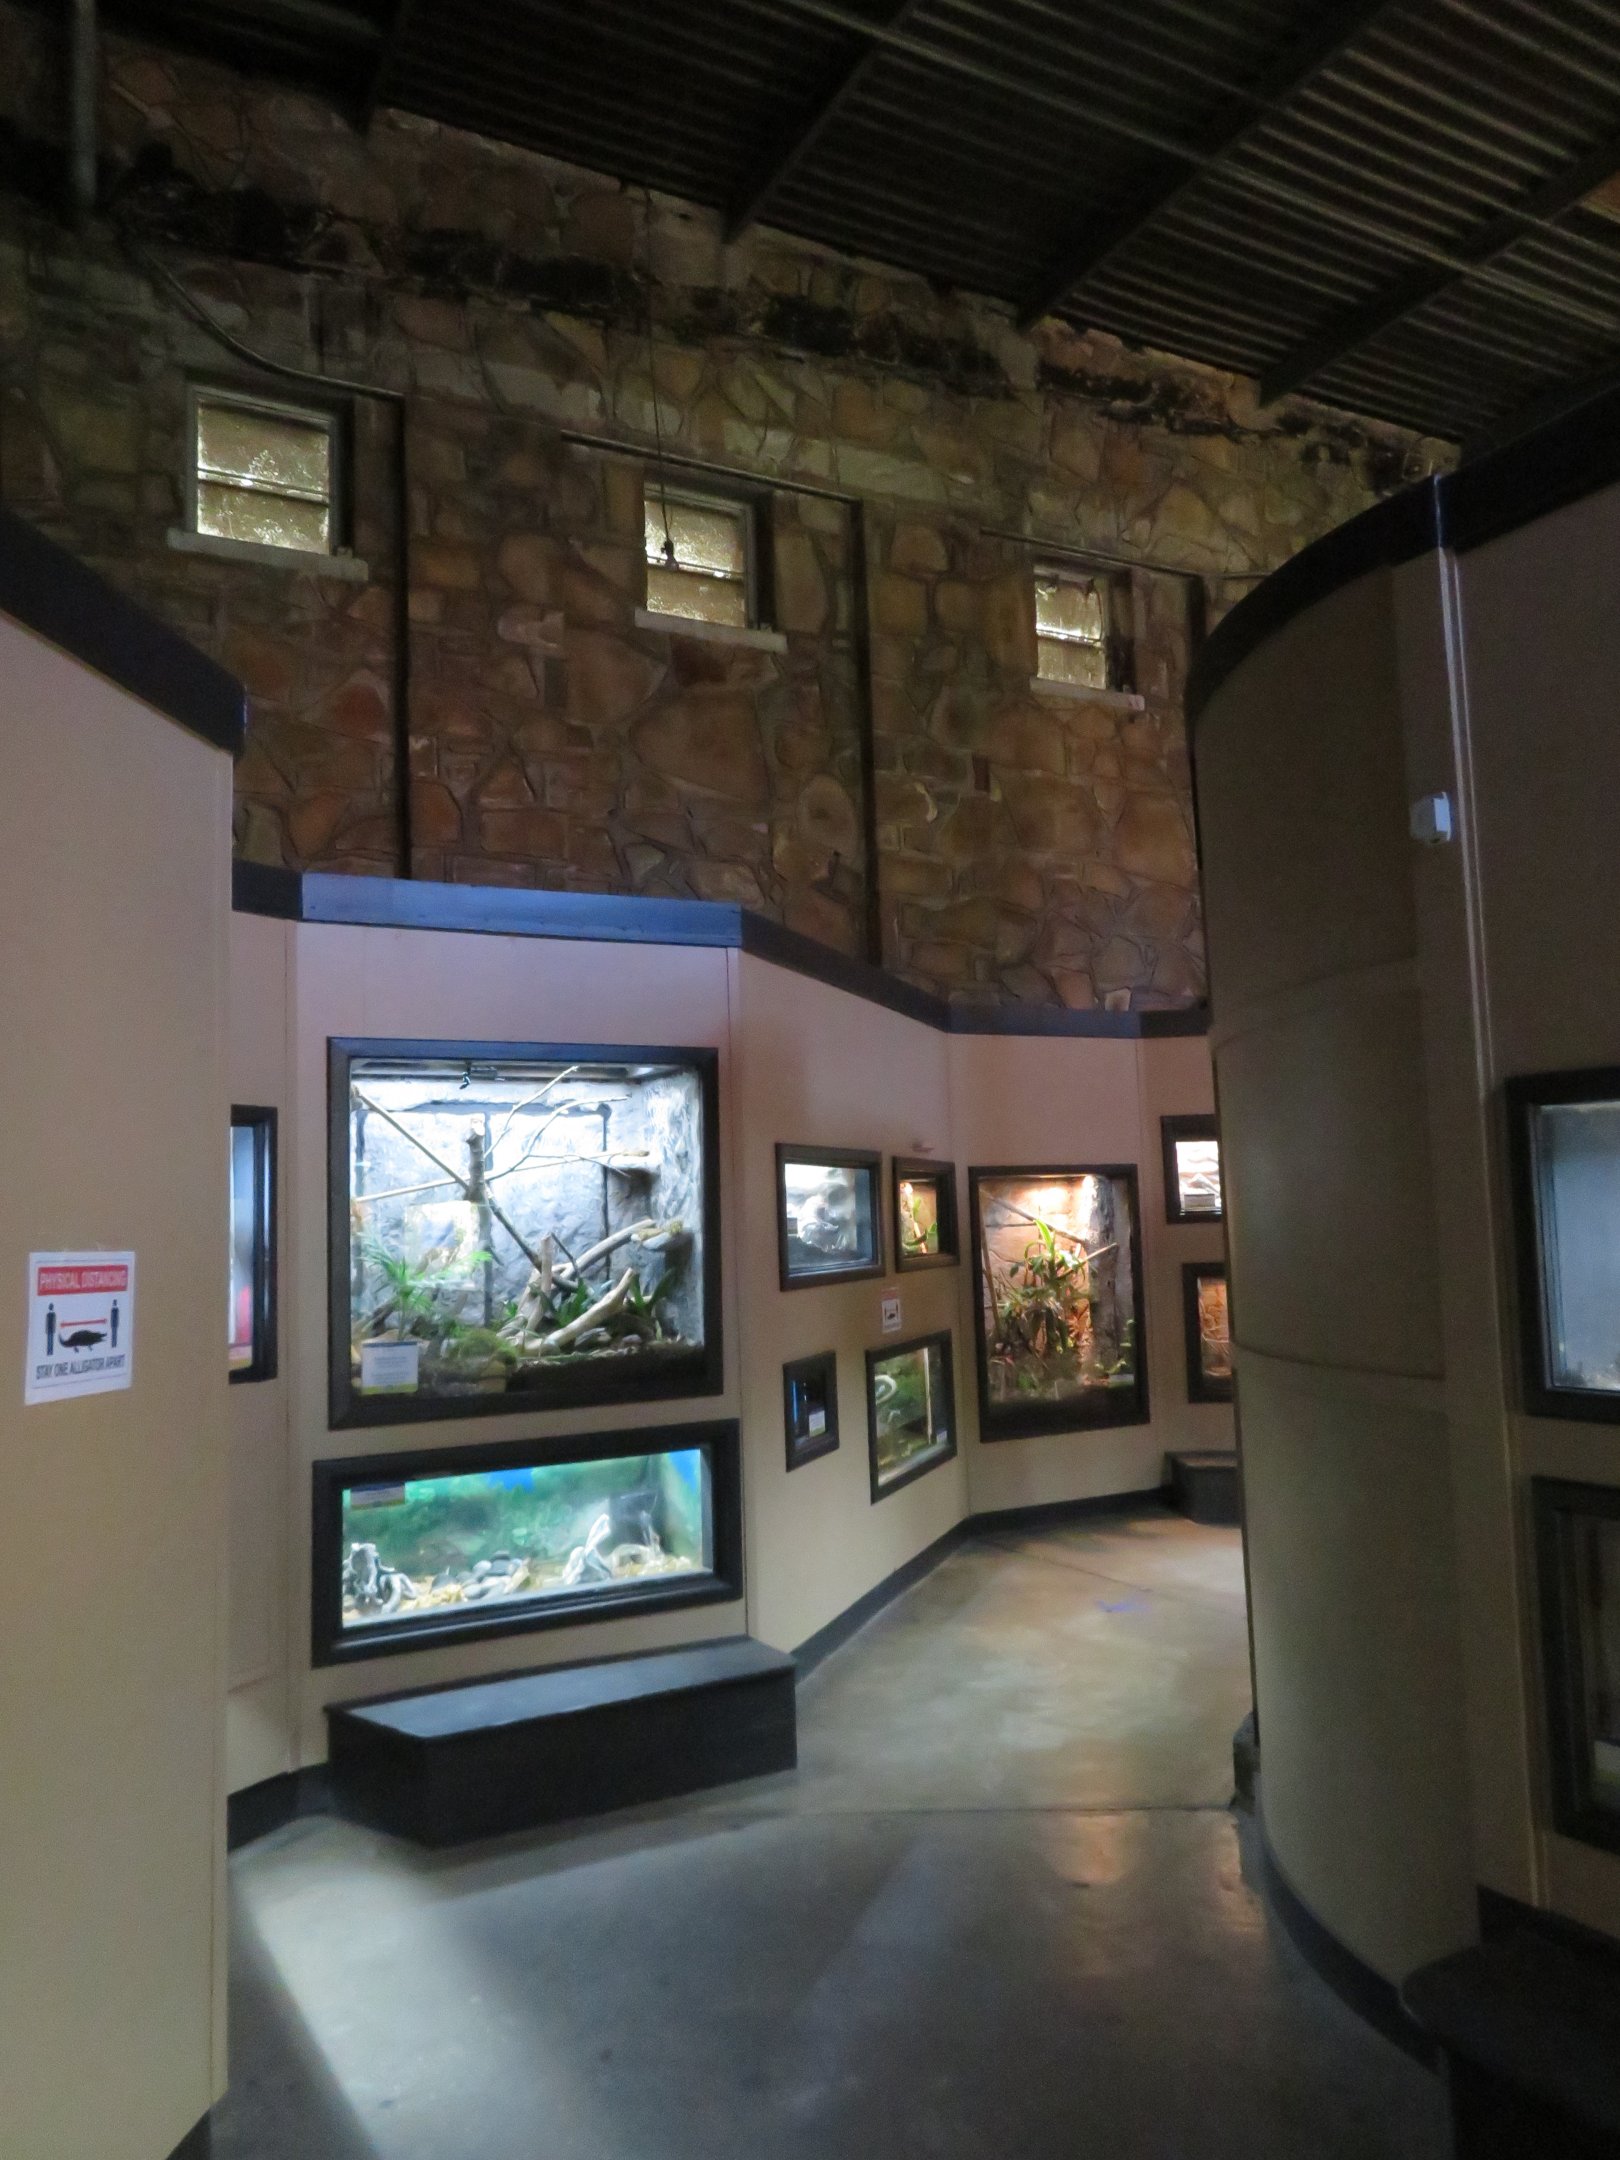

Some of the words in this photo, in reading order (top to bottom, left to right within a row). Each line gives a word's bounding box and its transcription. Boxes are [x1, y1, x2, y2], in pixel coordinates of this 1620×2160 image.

[40, 1272, 80, 1289] PHYSICAL
[81, 1270, 127, 1288] DISTANCING
[36, 1364, 54, 1380] STAY
[54, 1361, 69, 1377] ONE
[70, 1357, 105, 1375] ALLIGATOR
[105, 1354, 126, 1369] APART
